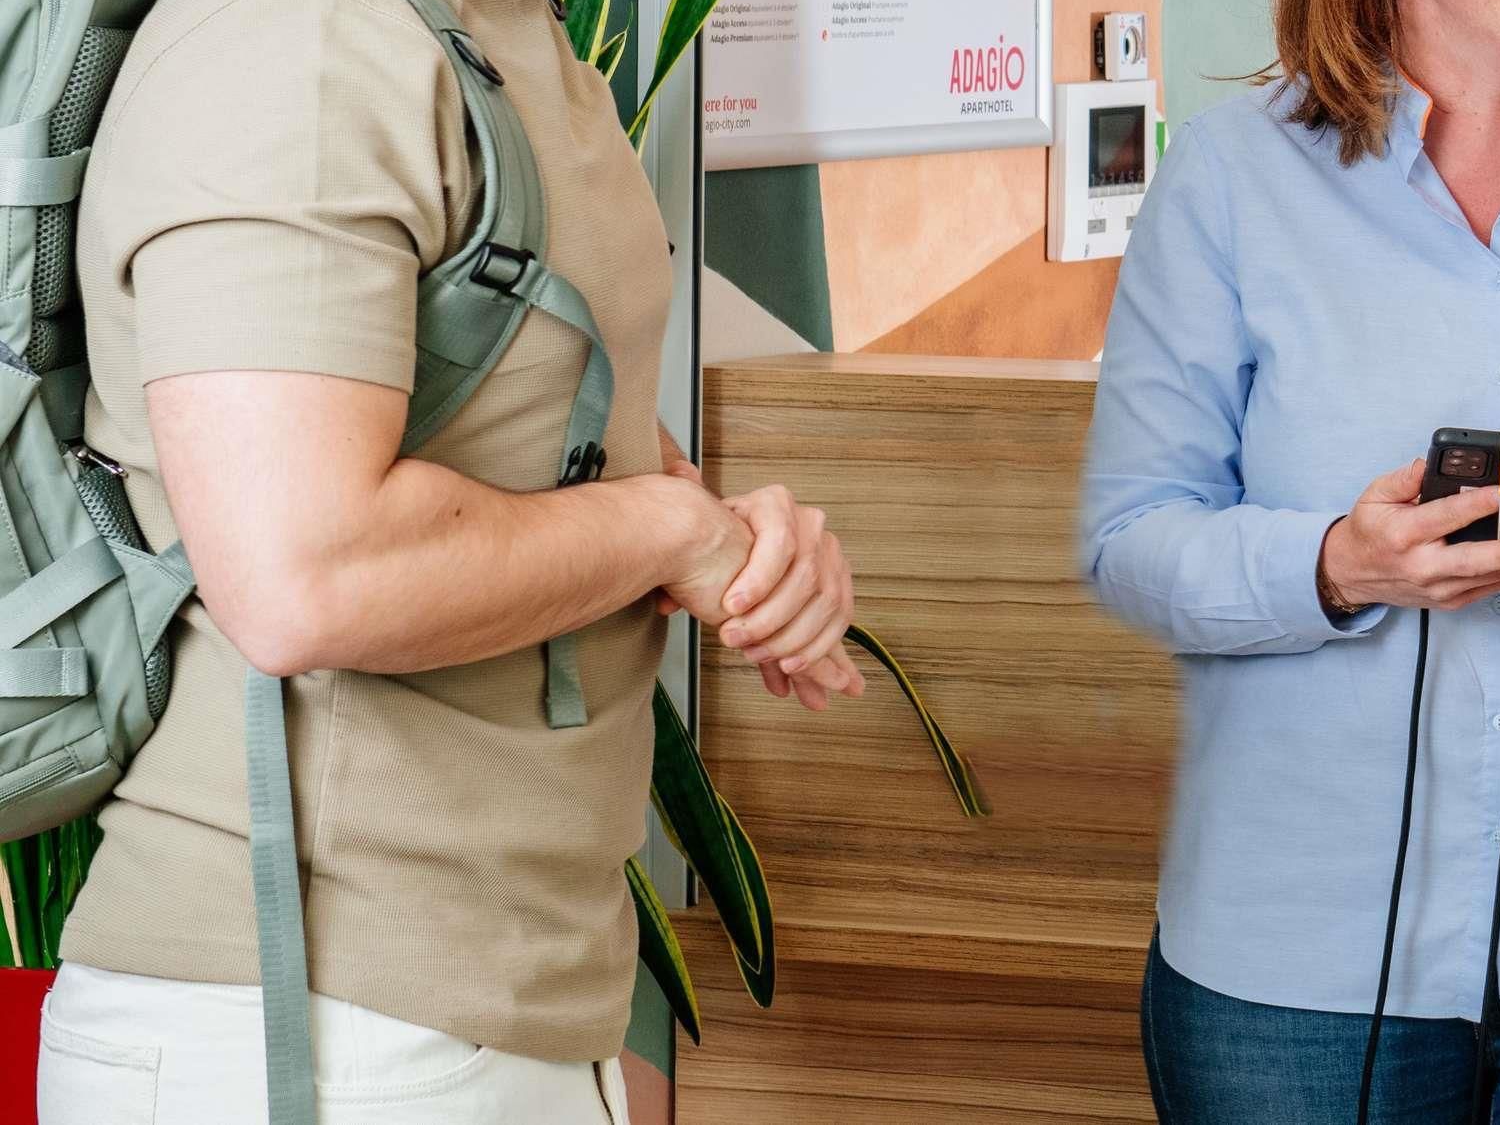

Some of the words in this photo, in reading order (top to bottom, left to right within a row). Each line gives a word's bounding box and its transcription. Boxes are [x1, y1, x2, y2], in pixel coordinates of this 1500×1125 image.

[723, 95, 737, 111] for
[739, 98, 758, 114] you
[961, 99, 1014, 115] APARTHOTEL
